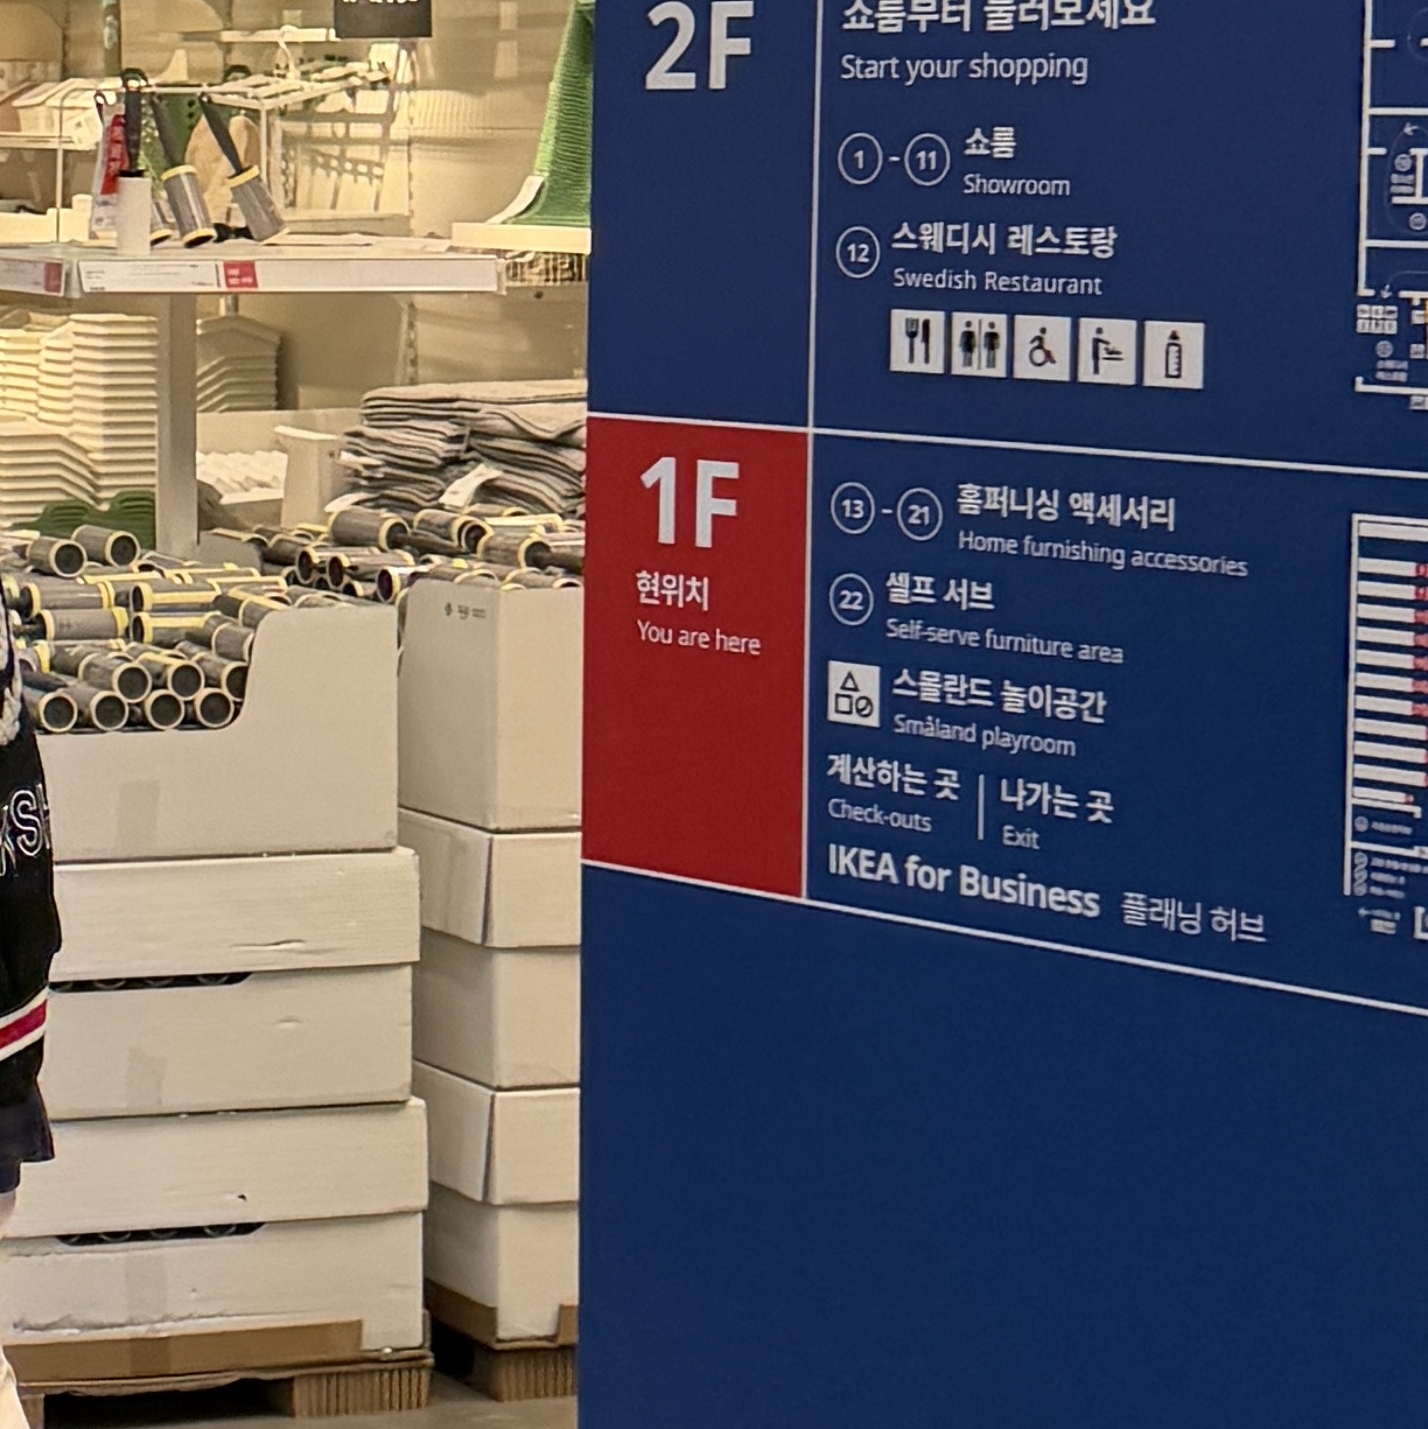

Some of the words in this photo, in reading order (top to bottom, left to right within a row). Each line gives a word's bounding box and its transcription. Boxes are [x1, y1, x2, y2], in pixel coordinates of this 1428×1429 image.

[646, 1, 754, 89] 2F
[841, 54, 899, 79] Start
[905, 59, 964, 85] your
[969, 52, 1088, 85] shopping
[964, 127, 1017, 158] 쇼룸
[963, 173, 1070, 195] Showroom
[892, 222, 996, 255] 스웨디시
[1008, 224, 1118, 258] 레스토랑
[894, 268, 977, 290] Swedish
[985, 271, 1102, 295] Restaurant
[640, 457, 739, 548] 1F
[957, 483, 1059, 521] 홈퍼니싱
[1069, 492, 1175, 531] 액세서리
[959, 530, 1018, 554] Home
[1023, 535, 1125, 570] furnishing
[1131, 550, 1248, 576] accessories
[636, 570, 708, 611] 현위치
[886, 572, 936, 604] 셀프
[943, 578, 995, 610] 서브
[637, 619, 672, 644] You
[678, 630, 710, 649] are
[716, 628, 761, 655] here
[886, 618, 980, 647] Self-serve
[985, 628, 1074, 658] furniture
[1078, 644, 1124, 663] area
[892, 669, 994, 706] 스몰란드
[1000, 680, 1107, 723] 놀이공간
[893, 714, 977, 742] Småland
[982, 726, 1076, 756] playroom
[827, 754, 928, 795] 계산하는
[934, 768, 961, 800] 곳
[828, 798, 932, 832] Check-outs
[1001, 778, 1079, 818] 나가는
[1086, 790, 1114, 823] 곳
[1003, 825, 1040, 849] Exit
[829, 843, 899, 884] IKEA
[905, 855, 952, 891] for
[960, 865, 1100, 917] Business
[1121, 892, 1201, 934] 플래닝
[1209, 906, 1267, 942] 허브
